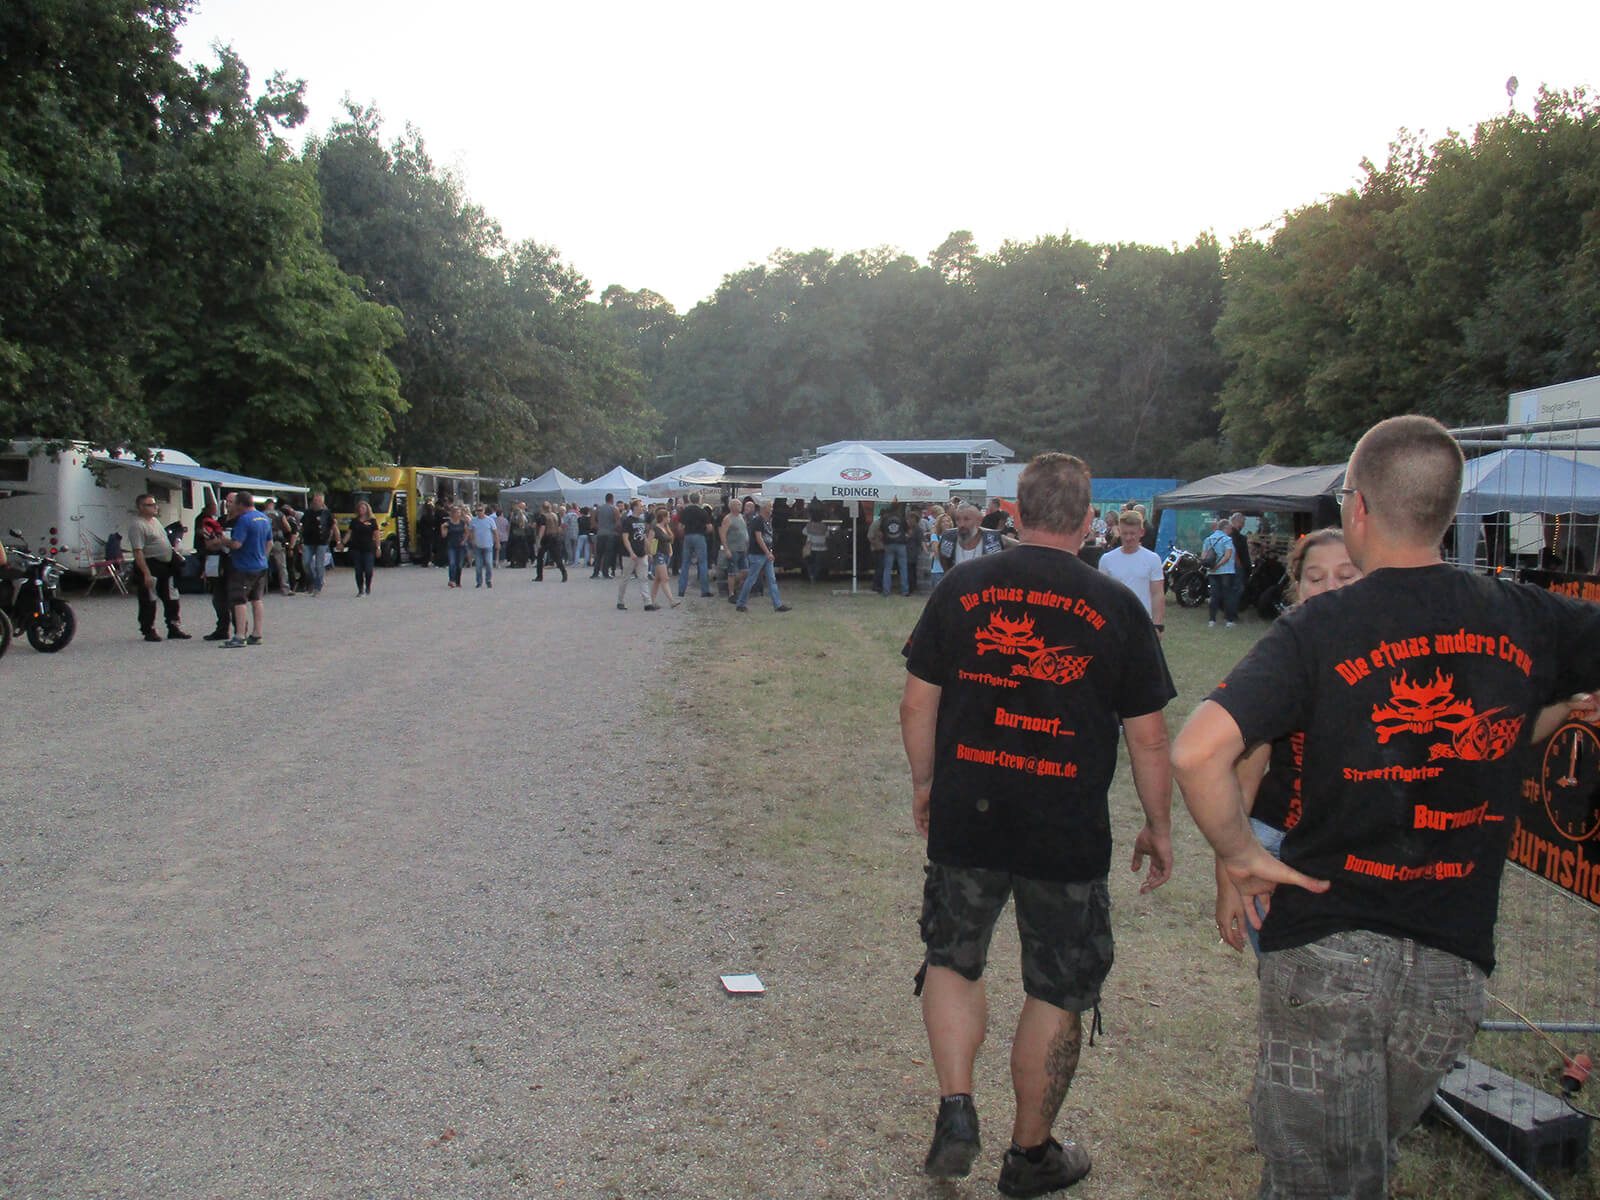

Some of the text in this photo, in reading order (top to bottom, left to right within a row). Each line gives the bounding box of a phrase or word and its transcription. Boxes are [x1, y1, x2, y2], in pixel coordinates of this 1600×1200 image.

[832, 486, 880, 498] ERDINGER
[959, 585, 1106, 631] Die etwas andere Crew
[1334, 628, 1534, 687] Die etwas andere Crew
[956, 743, 1078, 779] Burnout-Crew@gmx.de
[1343, 765, 1444, 783] Streetfighter
